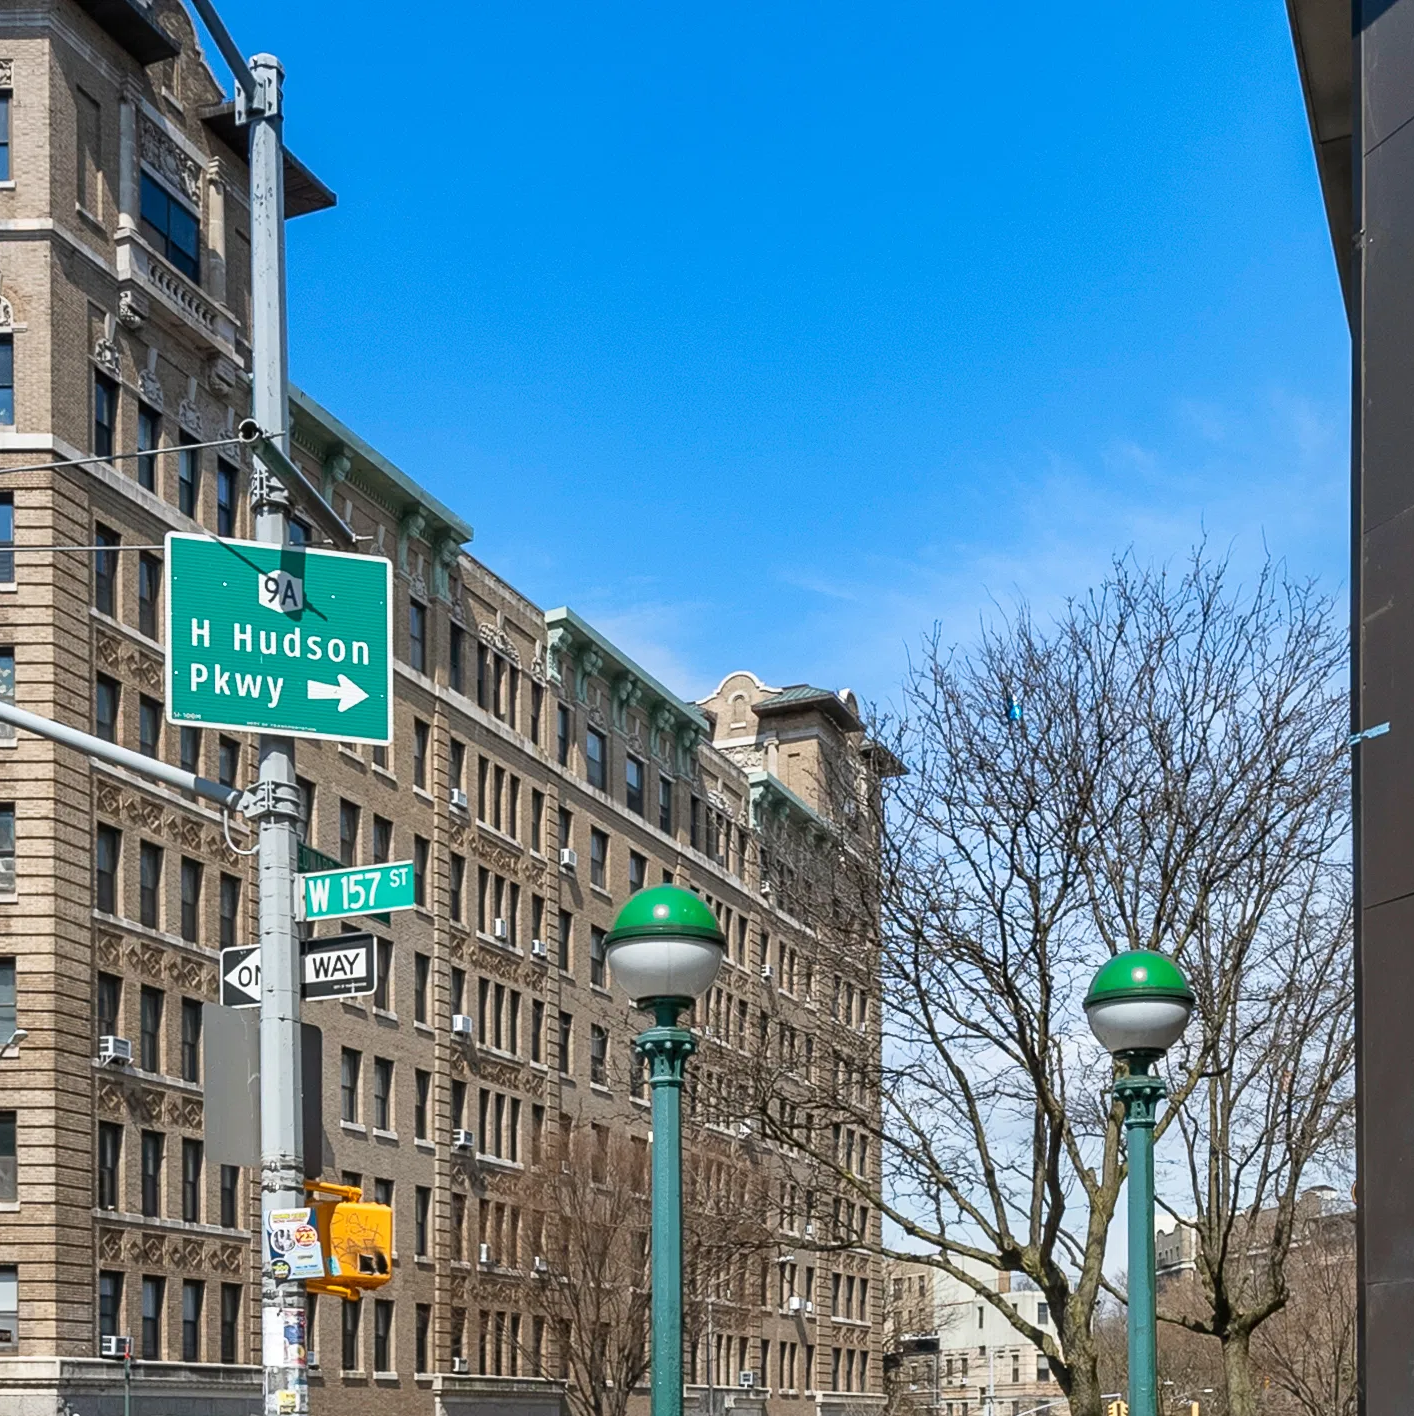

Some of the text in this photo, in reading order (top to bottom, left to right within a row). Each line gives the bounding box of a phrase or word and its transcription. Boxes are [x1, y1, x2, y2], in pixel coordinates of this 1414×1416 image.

[264, 577, 299, 607] 9A
[191, 618, 370, 666] H Hudson
[190, 663, 284, 708] Pkwy
[308, 868, 408, 913] W 157 ST
[312, 952, 361, 979] WAY
